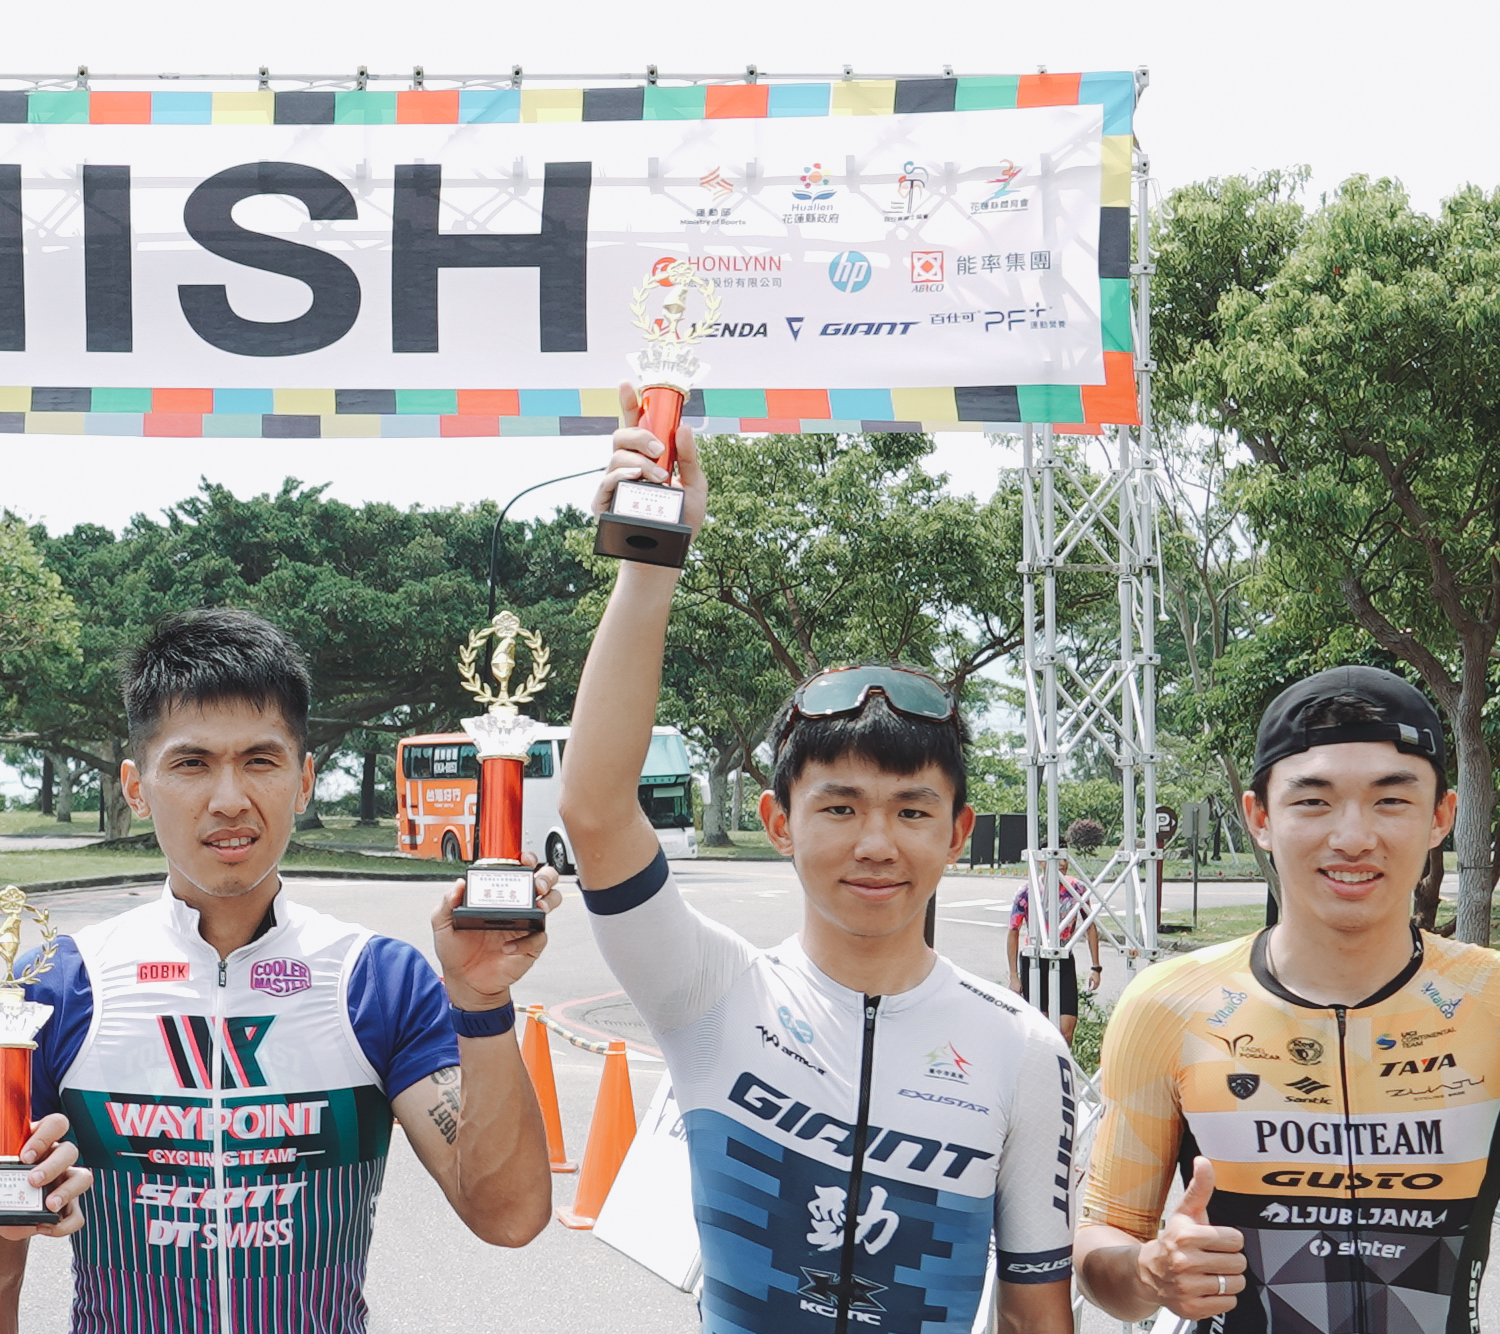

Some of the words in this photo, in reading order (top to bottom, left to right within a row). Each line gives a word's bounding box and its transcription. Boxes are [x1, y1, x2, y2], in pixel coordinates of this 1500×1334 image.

[791, 203, 834, 212] Hualien
[688, 255, 782, 272] HONLYNN
[832, 251, 870, 292] hp
[818, 321, 922, 336] GIANT
[139, 964, 187, 981] GOBIK
[254, 960, 309, 978] COOLER
[253, 976, 310, 994] MASTER
[897, 1087, 990, 1116] EXUSTAR
[105, 1099, 330, 1141] WAYPOINT
[728, 1070, 996, 1180] GIANT
[1052, 1054, 1078, 1231] GIANT
[240, 1147, 298, 1164] TEAM
[1261, 1170, 1444, 1190] GUSTO
[132, 1180, 309, 1210] SCOTT
[1290, 1204, 1435, 1229] LJUBLJANA
[148, 1219, 203, 1248] DT
[201, 1217, 294, 1250] SWISS
[1337, 1240, 1406, 1259] sinter
